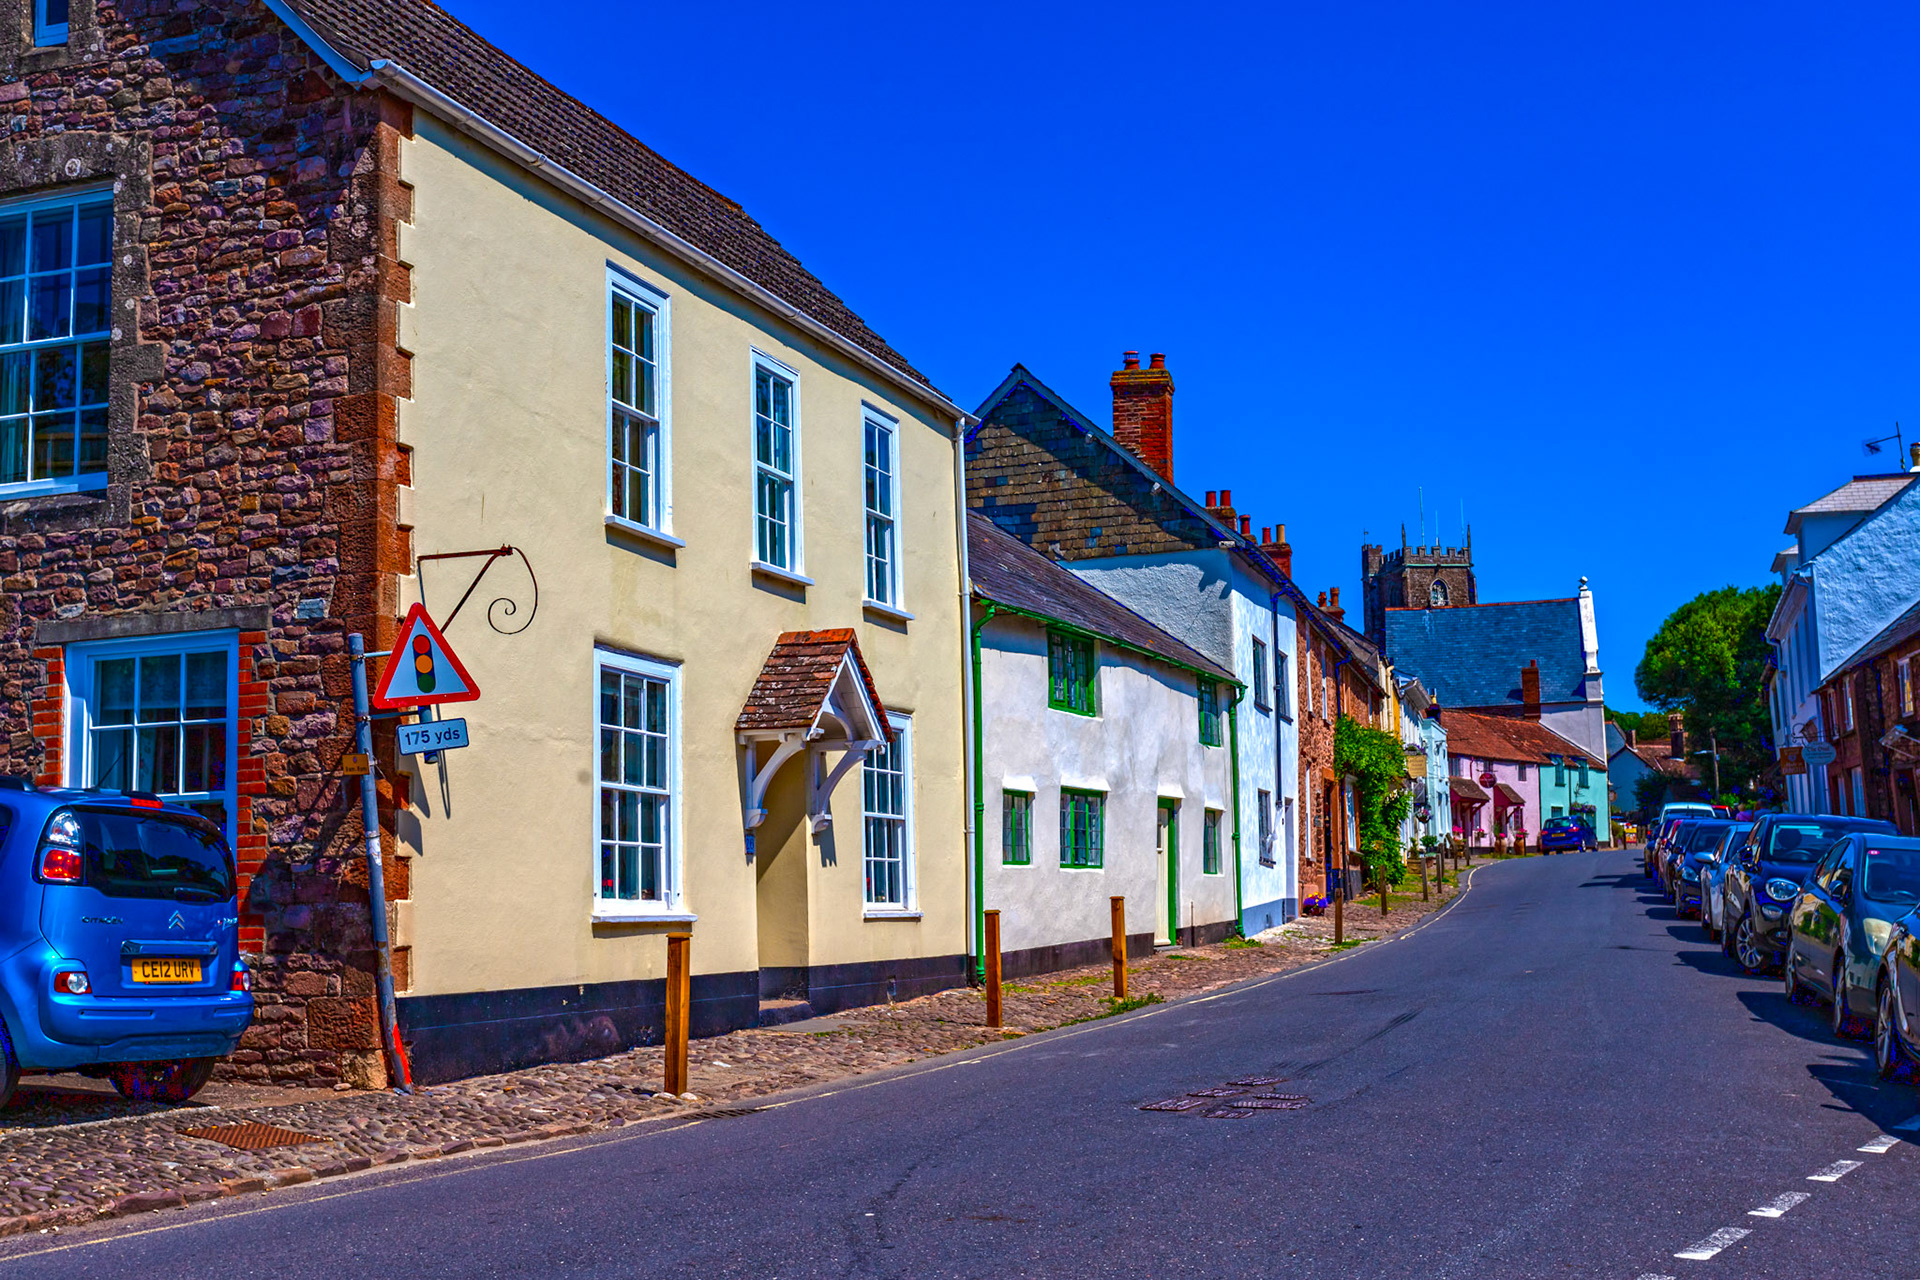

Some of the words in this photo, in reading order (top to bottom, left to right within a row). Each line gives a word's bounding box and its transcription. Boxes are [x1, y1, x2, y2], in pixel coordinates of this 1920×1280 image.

[405, 730, 430, 745] 175
[435, 727, 461, 744] yds
[142, 961, 171, 978] CE12
